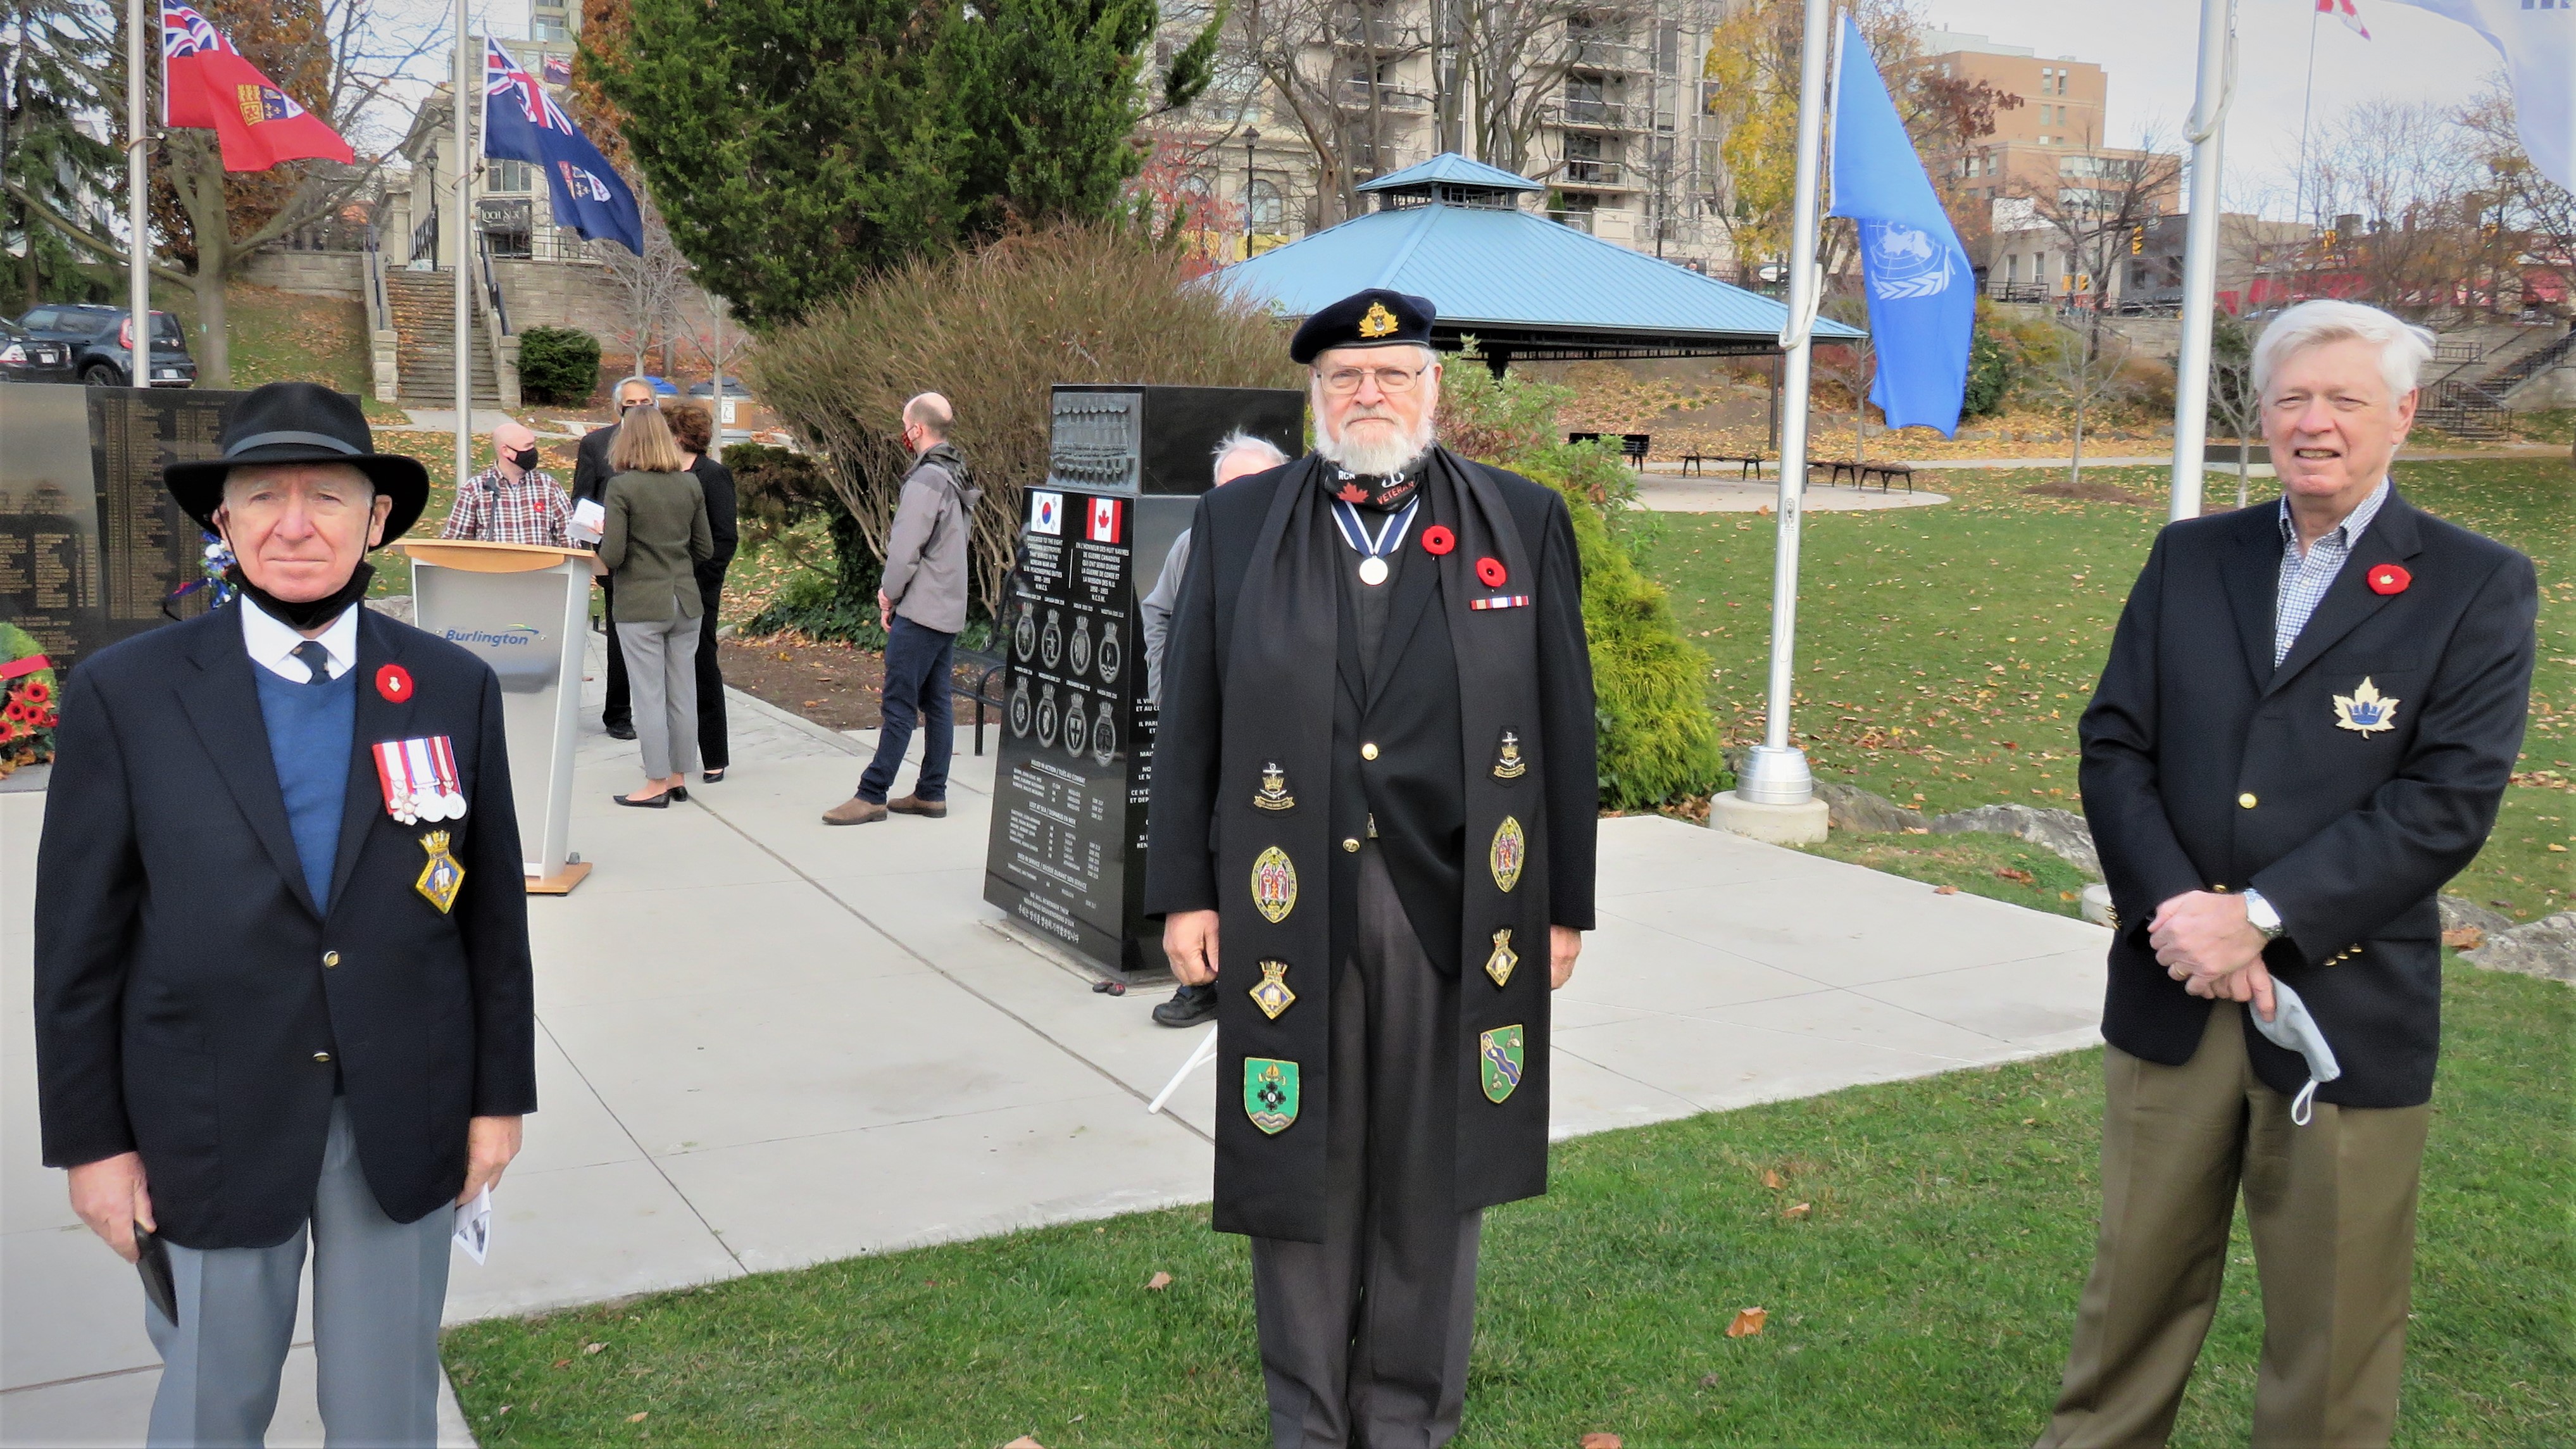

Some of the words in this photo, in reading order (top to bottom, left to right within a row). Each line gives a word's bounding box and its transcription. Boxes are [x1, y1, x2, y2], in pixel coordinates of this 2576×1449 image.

[1338, 470, 1356, 480] RCN
[1377, 480, 1415, 505] VETERAN
[446, 629, 528, 647] Burlington
